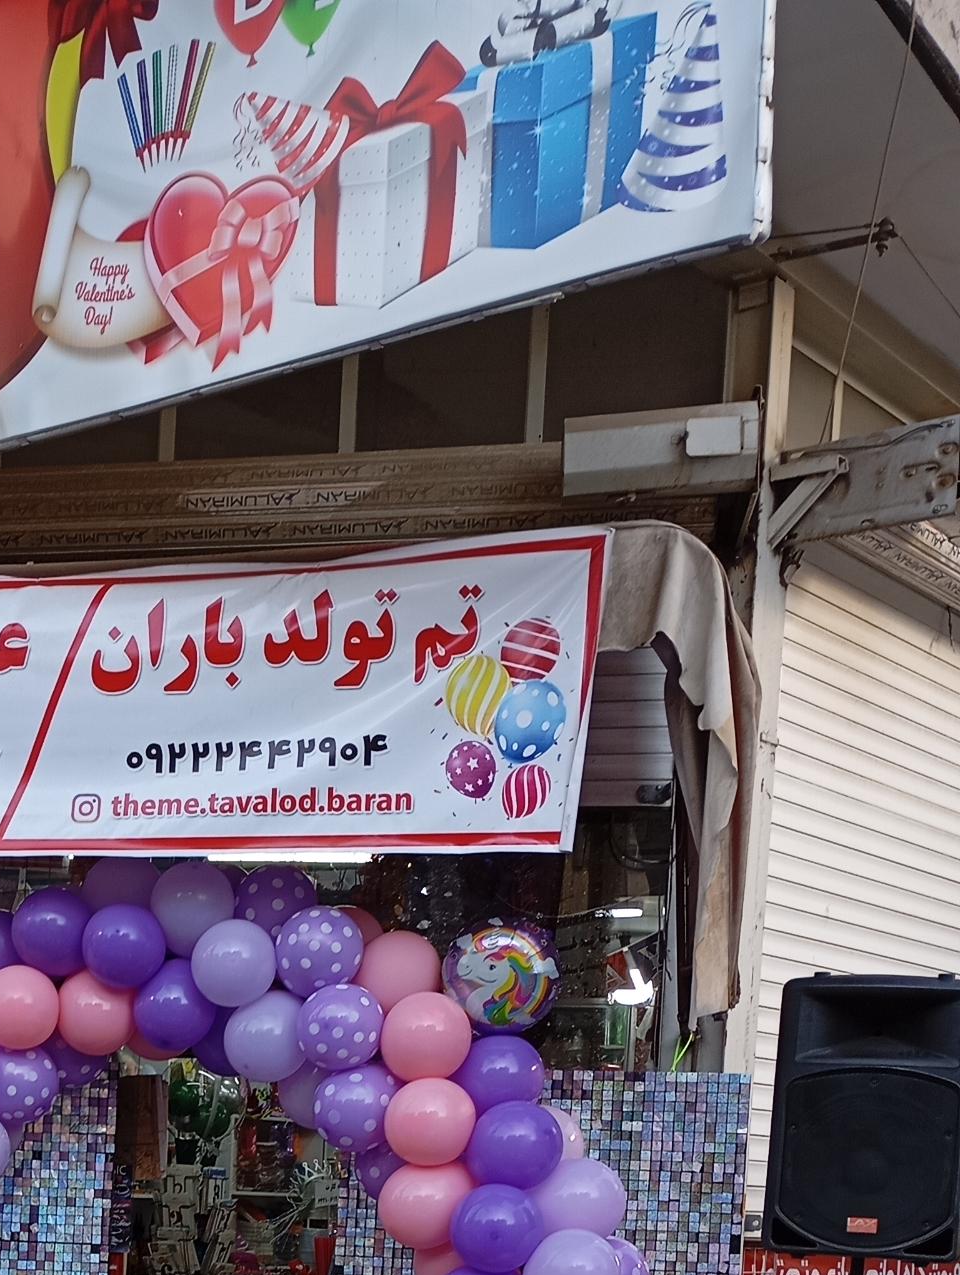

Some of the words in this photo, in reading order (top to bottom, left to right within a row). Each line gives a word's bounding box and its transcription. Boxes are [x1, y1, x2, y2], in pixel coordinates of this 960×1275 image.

[90, 256, 129, 285] Happy
[75, 281, 135, 302] Valentine's
[84, 306, 114, 335] Day!
[186, 492, 291, 509] ALUMIRAN
[90, 596, 246, 695] باران
[263, 588, 400, 690] تولد
[414, 584, 486, 684] تم
[126, 733, 389, 774] ۰۹۲۲۲۴۴۲۹۰۴
[111, 787, 413, 819] theme.tavalod.baran
